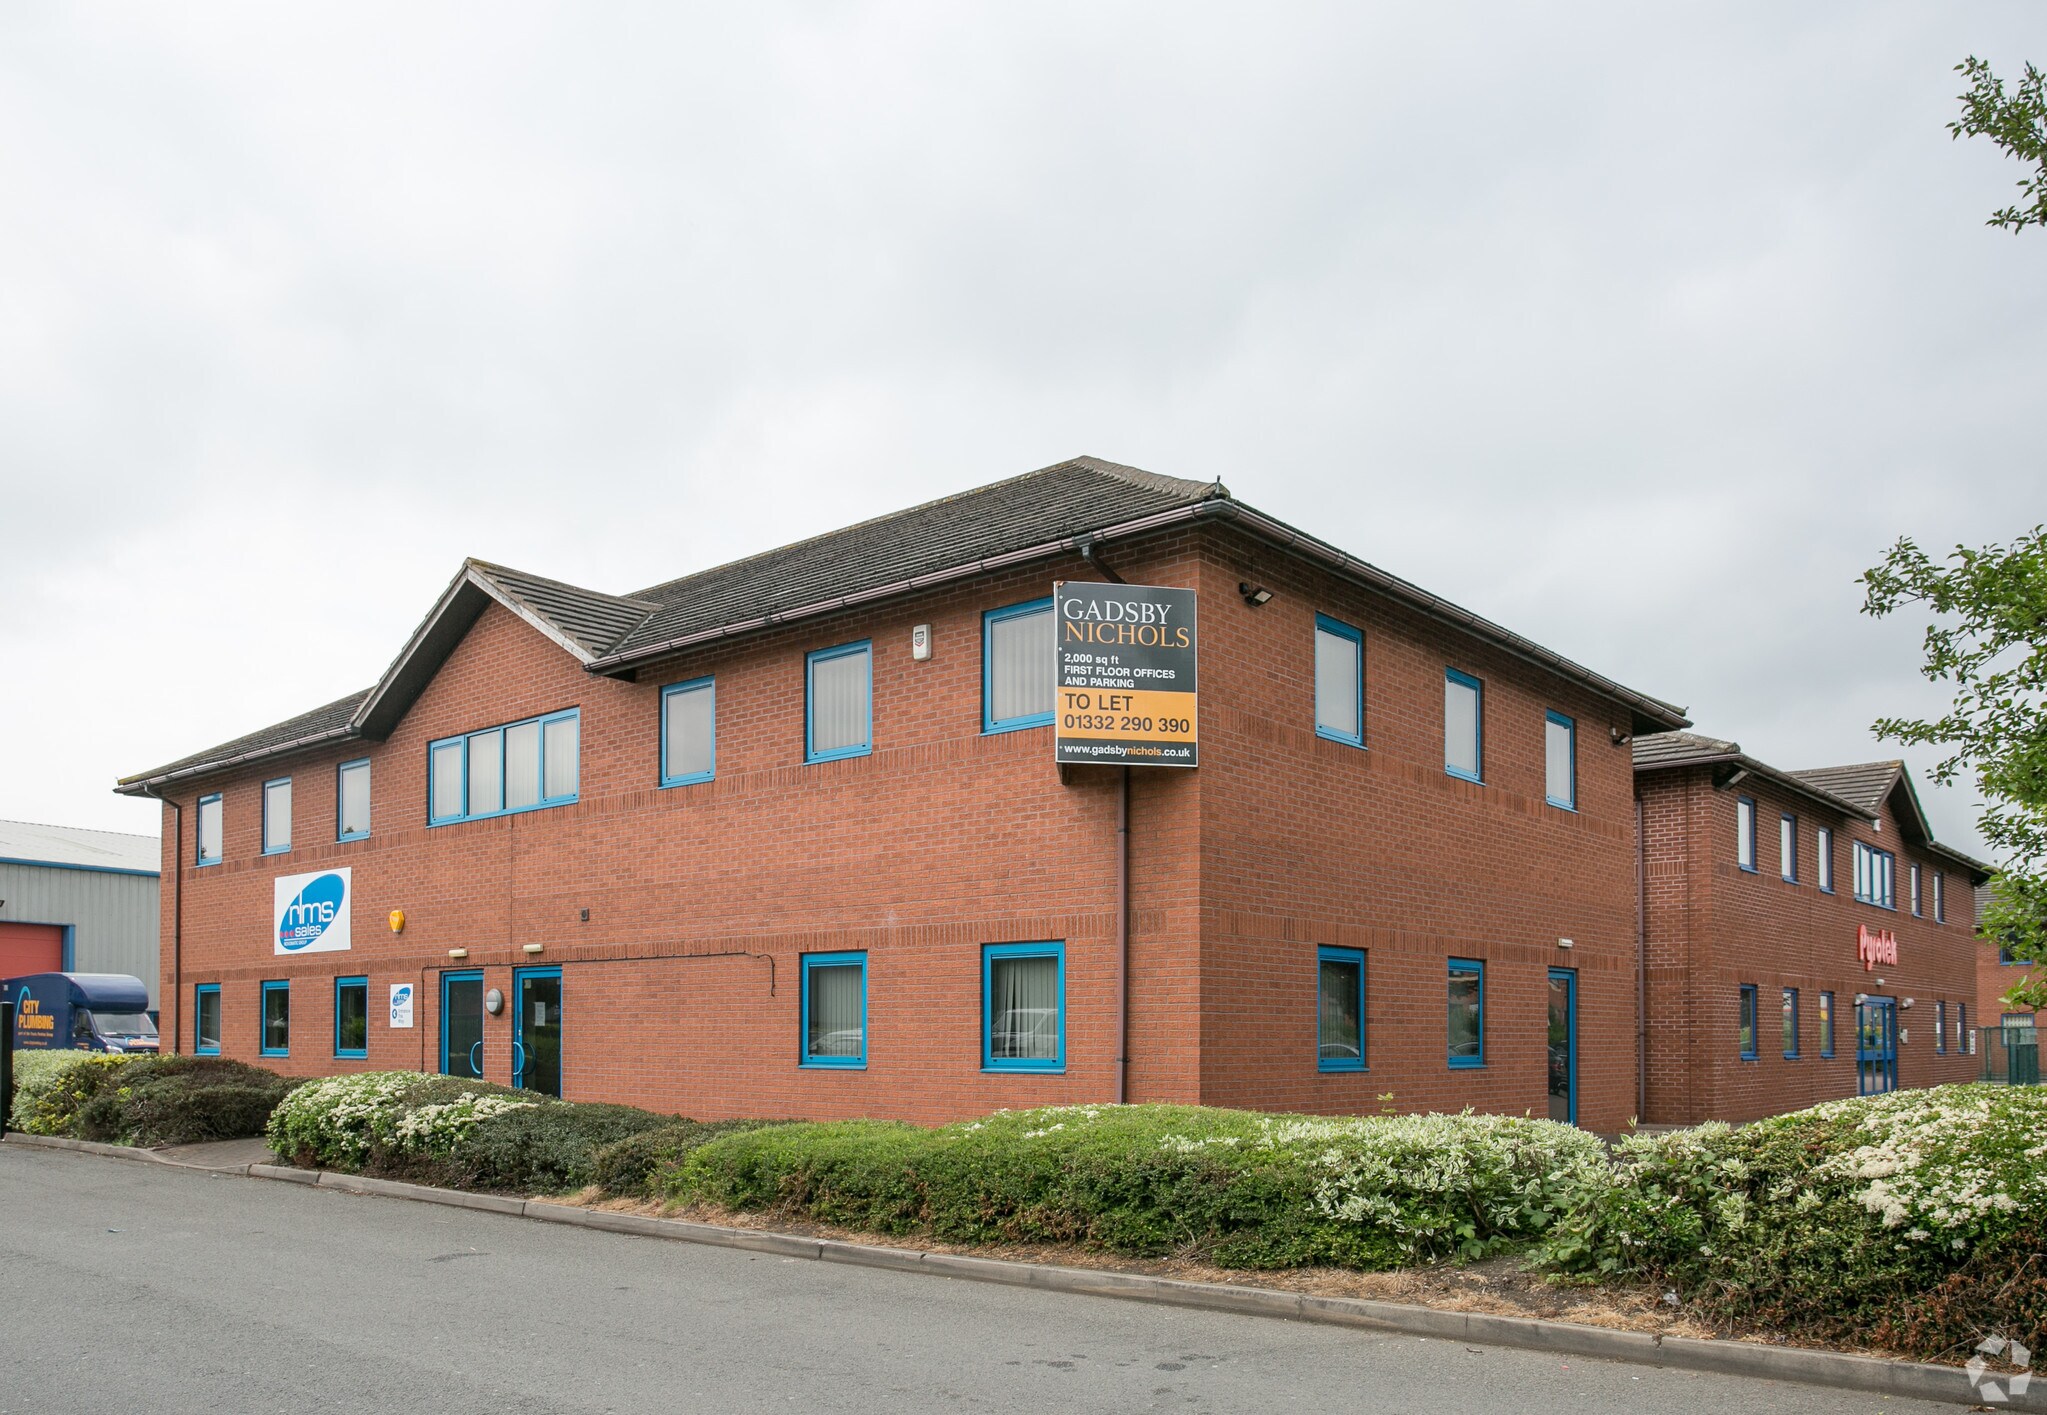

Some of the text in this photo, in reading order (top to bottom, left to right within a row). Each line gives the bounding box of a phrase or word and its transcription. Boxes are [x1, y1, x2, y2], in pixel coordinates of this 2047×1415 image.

[1063, 598, 1172, 625] GADSBY
[1064, 621, 1190, 648] NICHOLS
[1064, 653, 1119, 666] 2,000 sq ft
[1064, 665, 1176, 679] FIRST FLOOR OFFICES
[1064, 676, 1135, 688] AND PARKING
[1065, 693, 1134, 712] TO LET
[1064, 714, 1190, 733] 01332 290 390
[1064, 744, 1191, 758] www.gadsbynichols.co.uk
[294, 923, 322, 938] sales
[23, 1000, 39, 1014] CITY
[18, 1015, 54, 1030] PLUMBING
